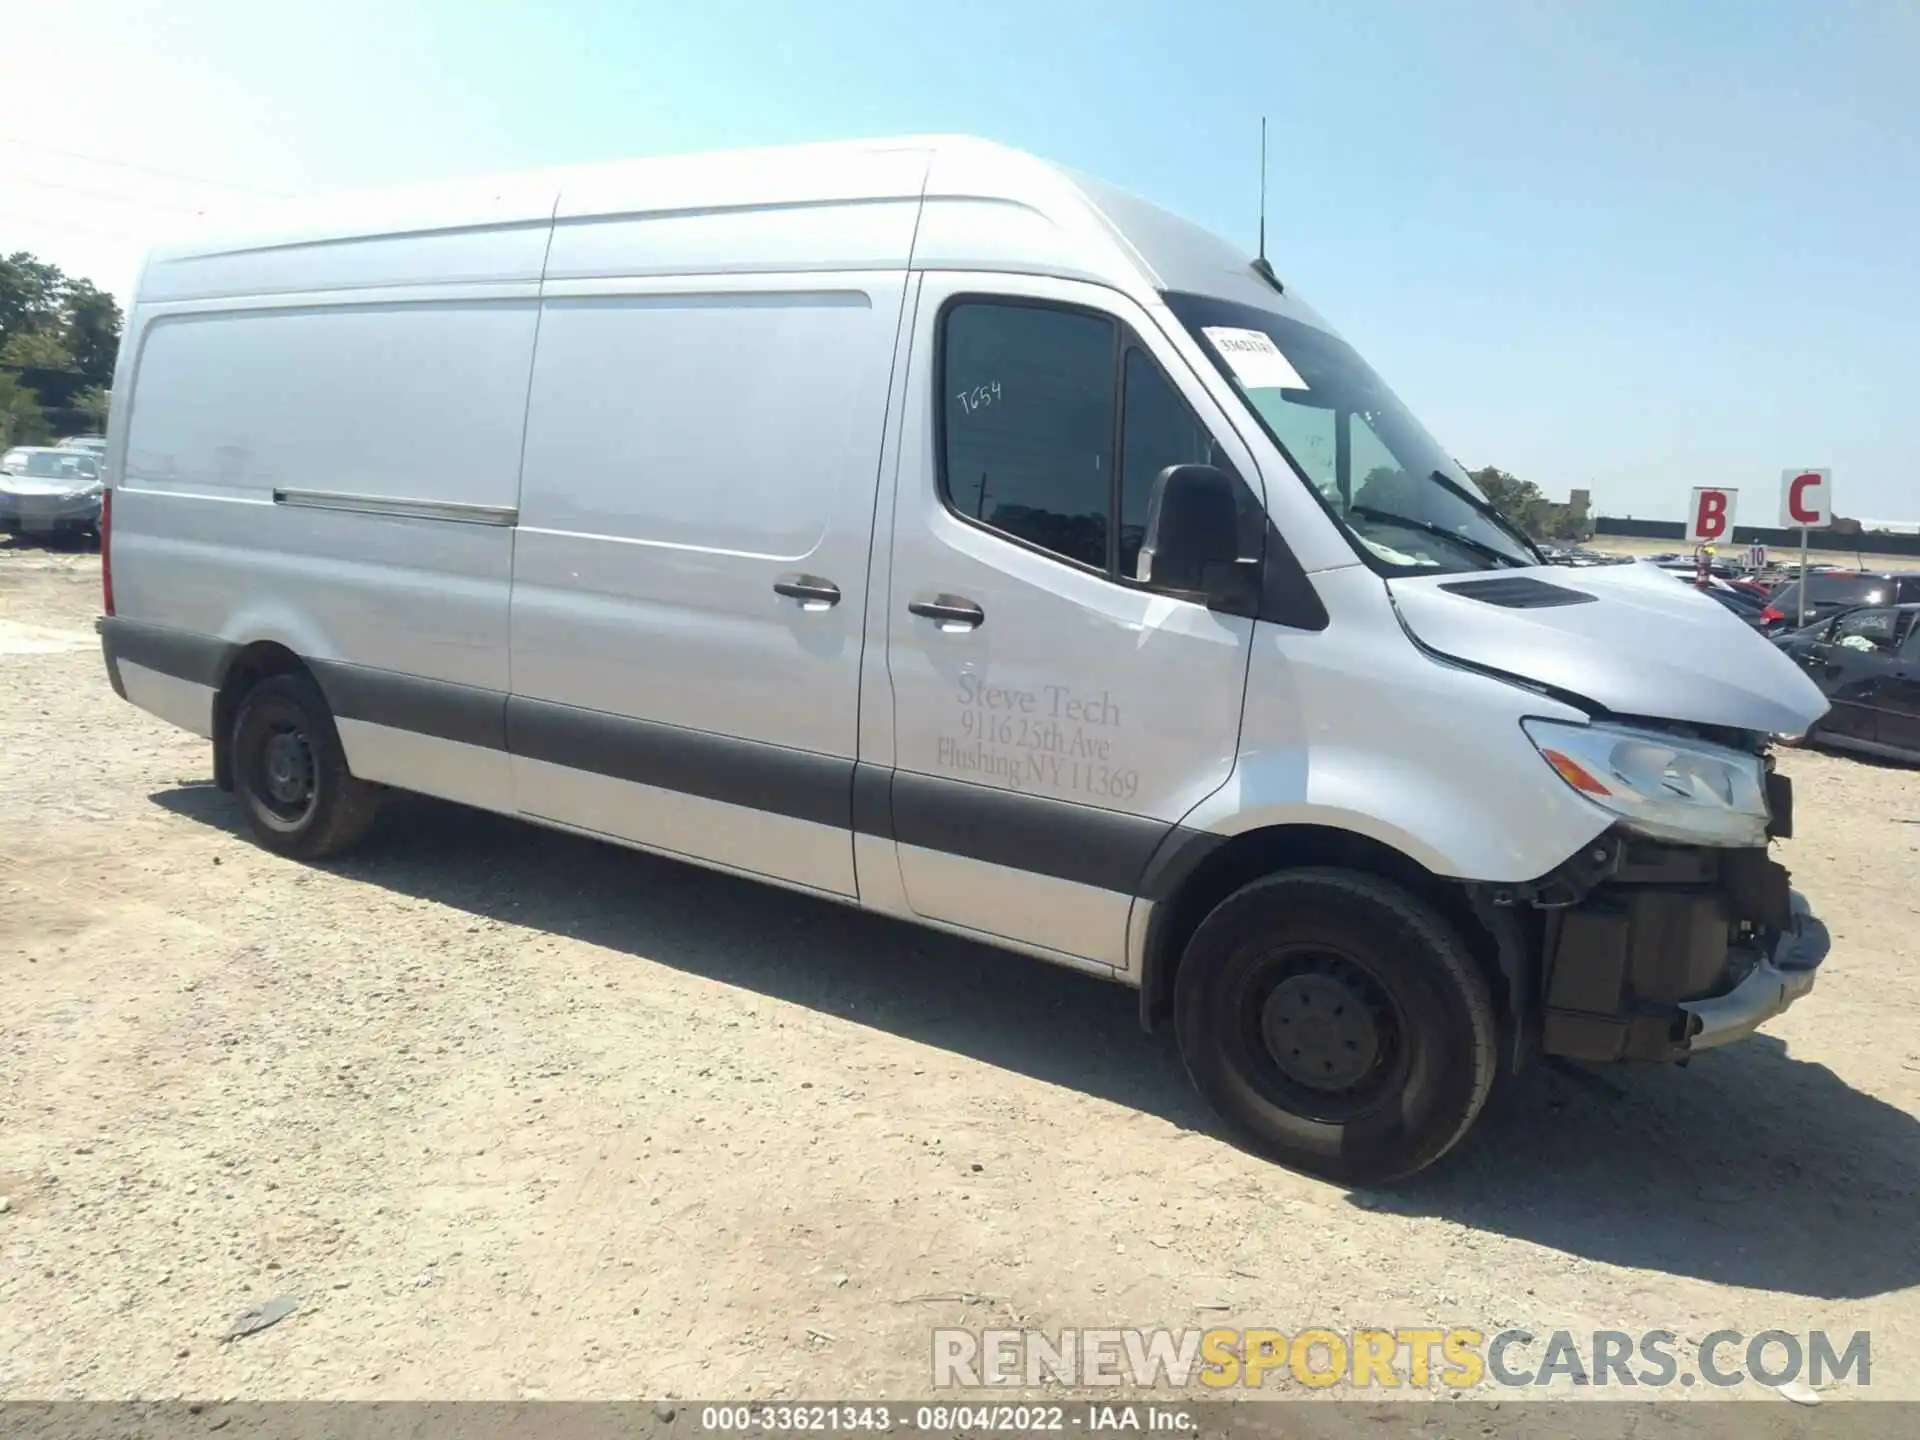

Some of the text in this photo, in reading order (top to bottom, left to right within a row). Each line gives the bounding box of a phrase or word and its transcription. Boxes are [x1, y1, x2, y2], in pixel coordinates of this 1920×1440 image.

[1695, 491, 1727, 537] B
[1789, 473, 1821, 523] C
[1752, 547, 1765, 566] 10
[957, 674, 1120, 727] Steve Tech
[961, 710, 1111, 761] 9116 25th Ave
[937, 736, 1139, 798] Flushing NY 11369
